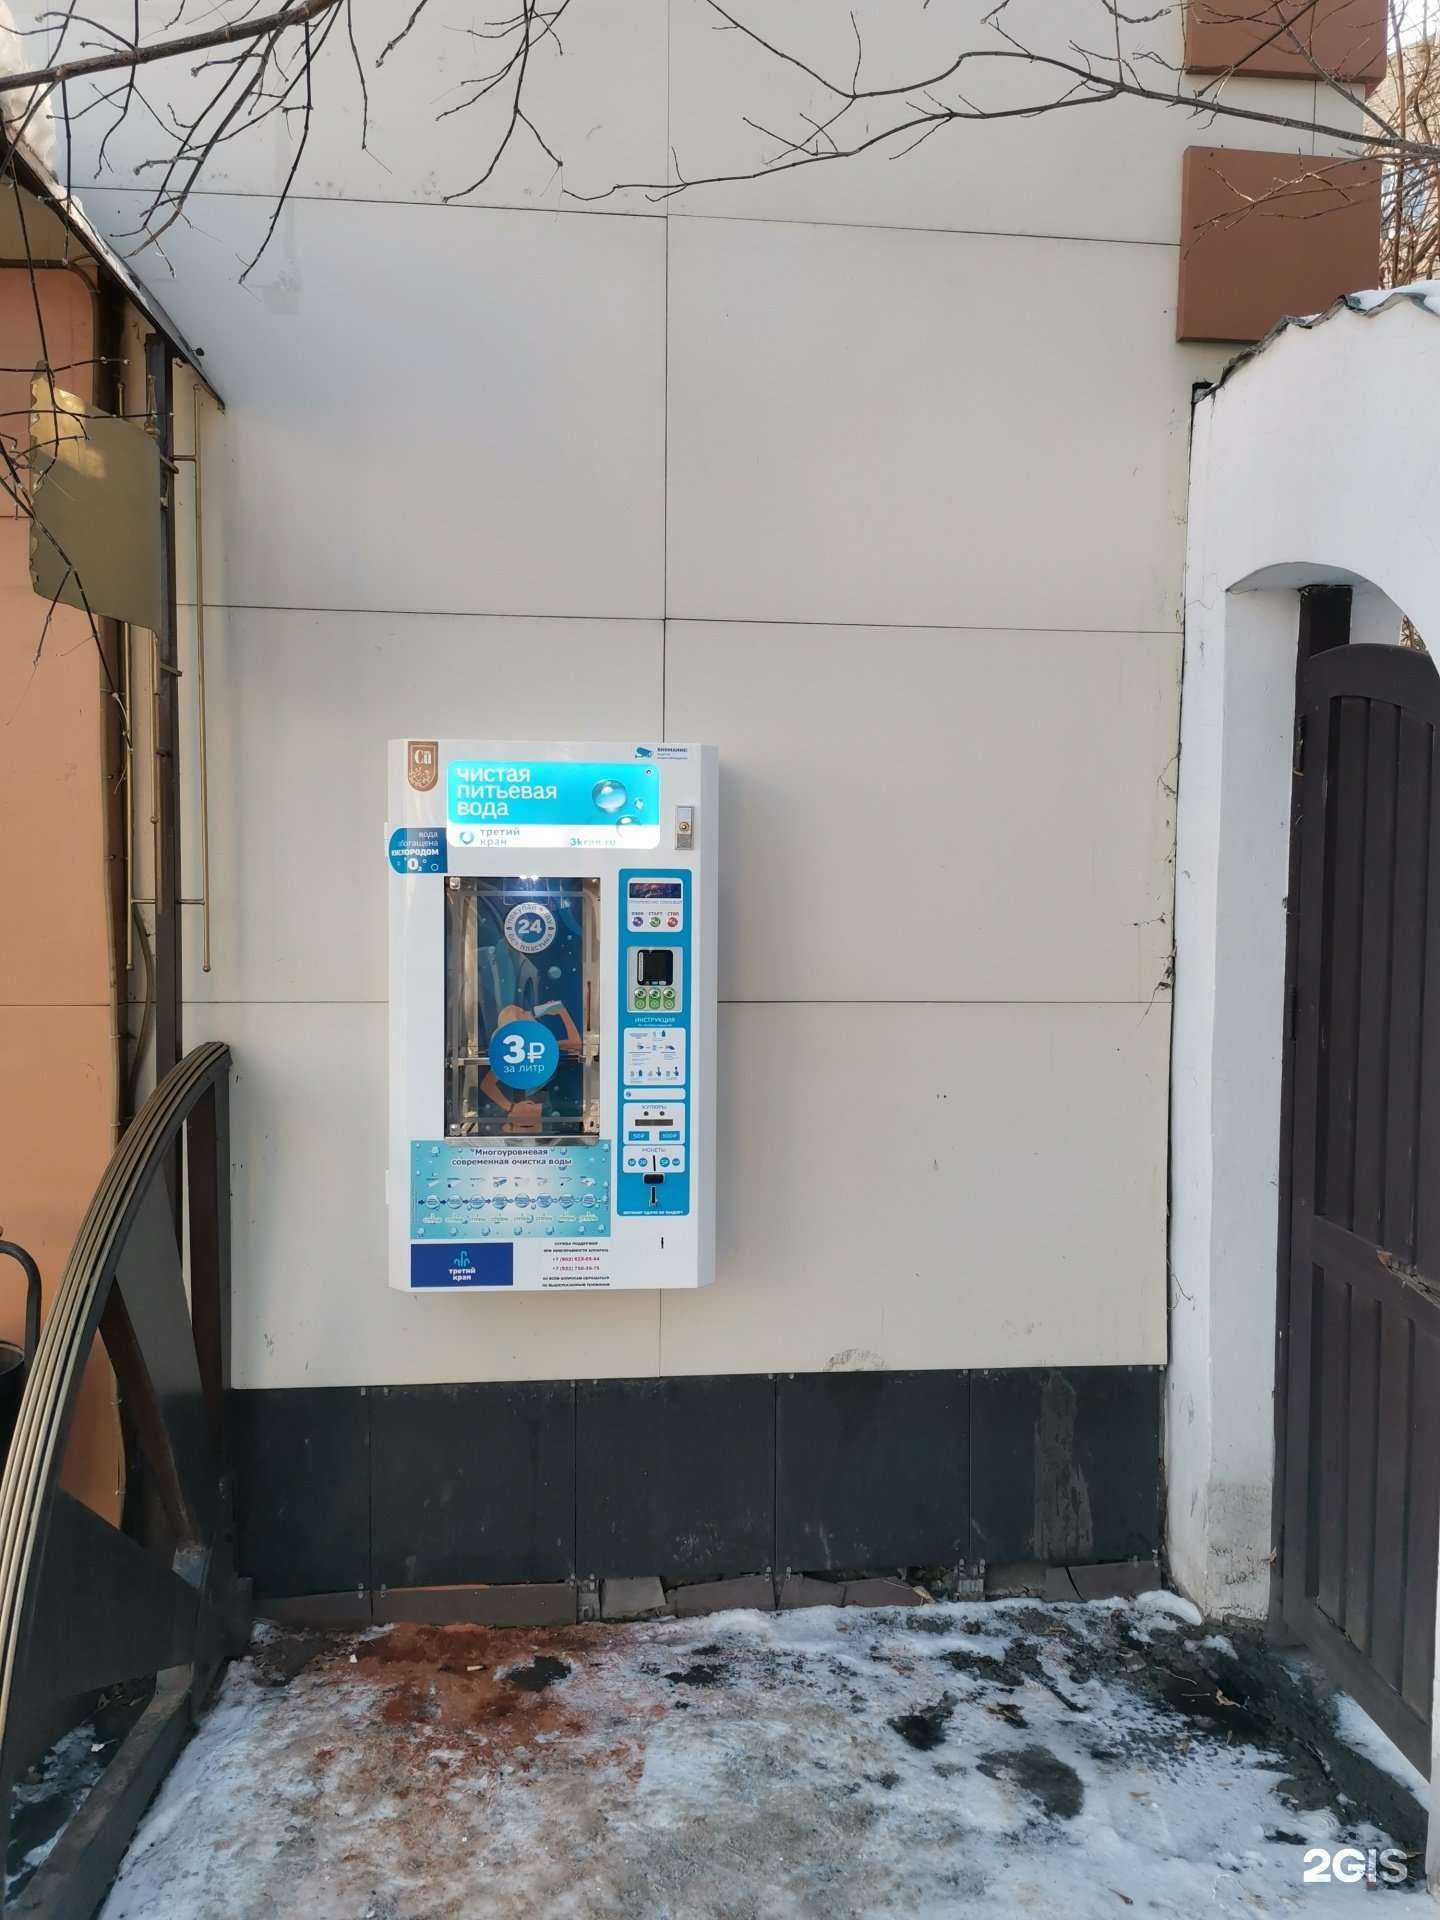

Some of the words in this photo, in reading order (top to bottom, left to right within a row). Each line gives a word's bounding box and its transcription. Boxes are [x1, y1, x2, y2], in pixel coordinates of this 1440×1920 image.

[455, 767, 531, 783] чистая
[455, 784, 558, 800] питьевая
[456, 801, 509, 819] вода
[418, 831, 438, 839] вода
[480, 827, 521, 837] третий
[480, 839, 507, 847] кран
[518, 919, 543, 934] 24
[503, 1065, 516, 1073] за
[518, 1064, 545, 1074] литр
[448, 1267, 476, 1276] третий
